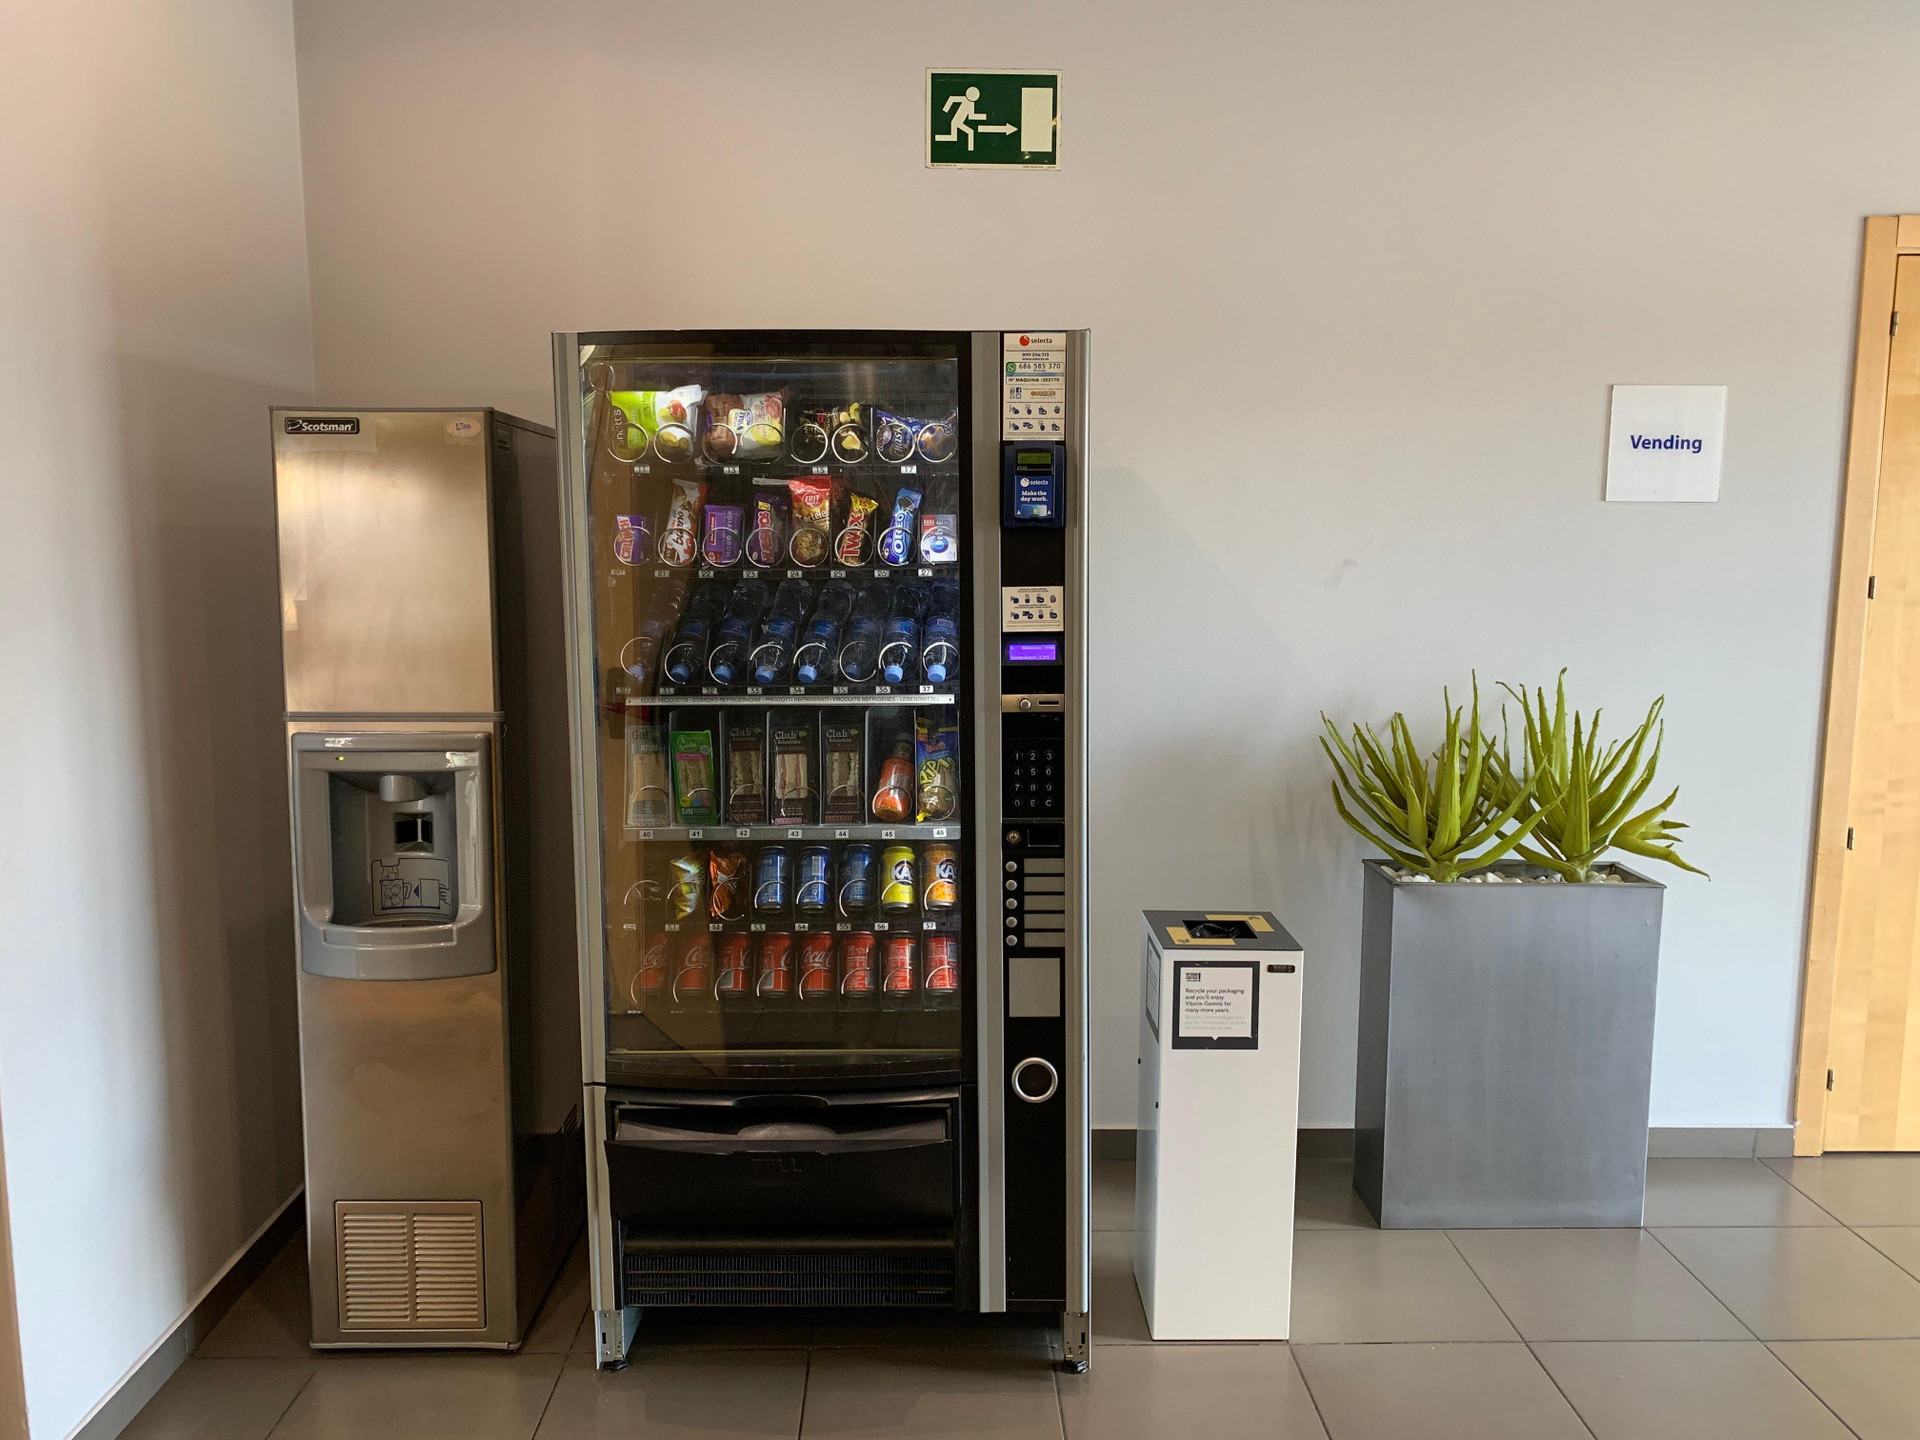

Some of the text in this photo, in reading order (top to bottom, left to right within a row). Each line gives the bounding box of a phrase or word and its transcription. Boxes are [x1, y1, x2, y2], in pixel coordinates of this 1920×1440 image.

[301, 422, 352, 431] Scotsman
[1630, 434, 1703, 454] Vending
[617, 516, 632, 562] CRUNCH
[672, 510, 684, 546] bueno
[758, 510, 774, 562] HUESITOS
[893, 513, 906, 554] OREO
[774, 731, 797, 740] Club
[826, 729, 848, 738] Club
